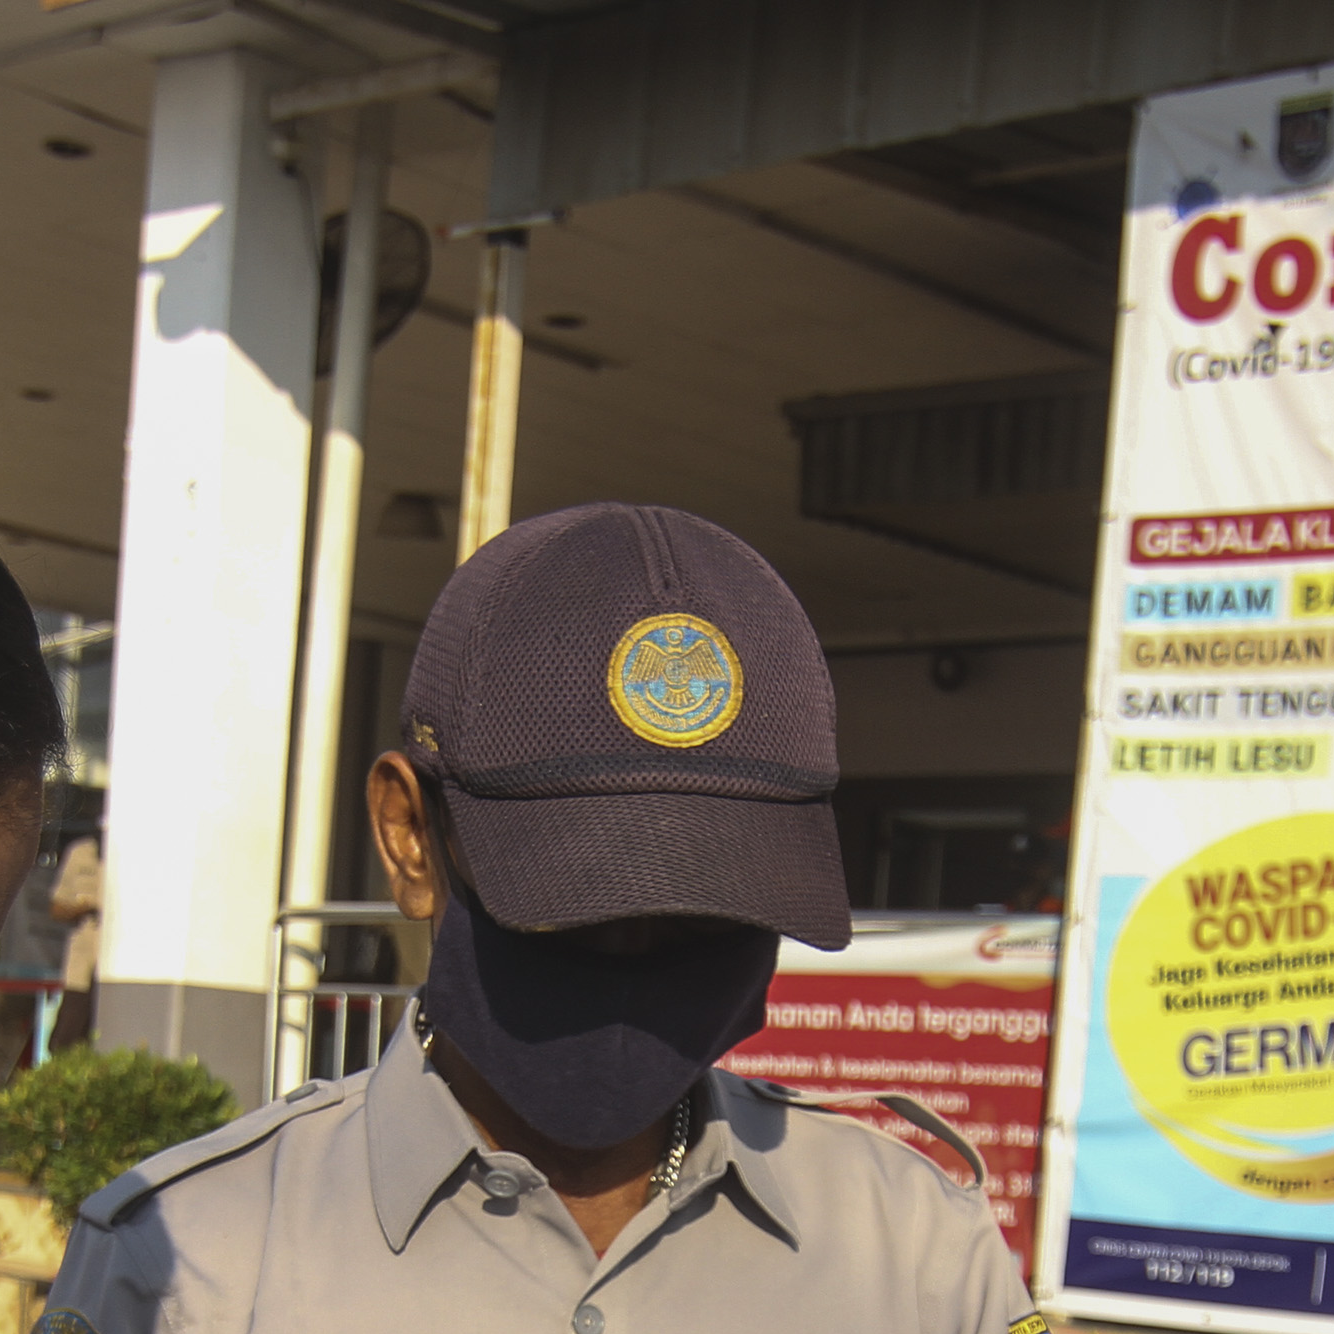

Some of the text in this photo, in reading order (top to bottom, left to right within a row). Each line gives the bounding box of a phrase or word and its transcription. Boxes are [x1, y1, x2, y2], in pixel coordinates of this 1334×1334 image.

[1136, 513, 1289, 558] GEJALA
[1131, 583, 1274, 619] DEMAM
[1131, 634, 1327, 670] GANGGUAN
[1120, 686, 1223, 719] SAKIT
[1113, 735, 1317, 773] LETIH LESU
[1148, 964, 1208, 988] Jaga
[847, 998, 916, 1032] Anda
[1162, 986, 1271, 1015] Keluarga
